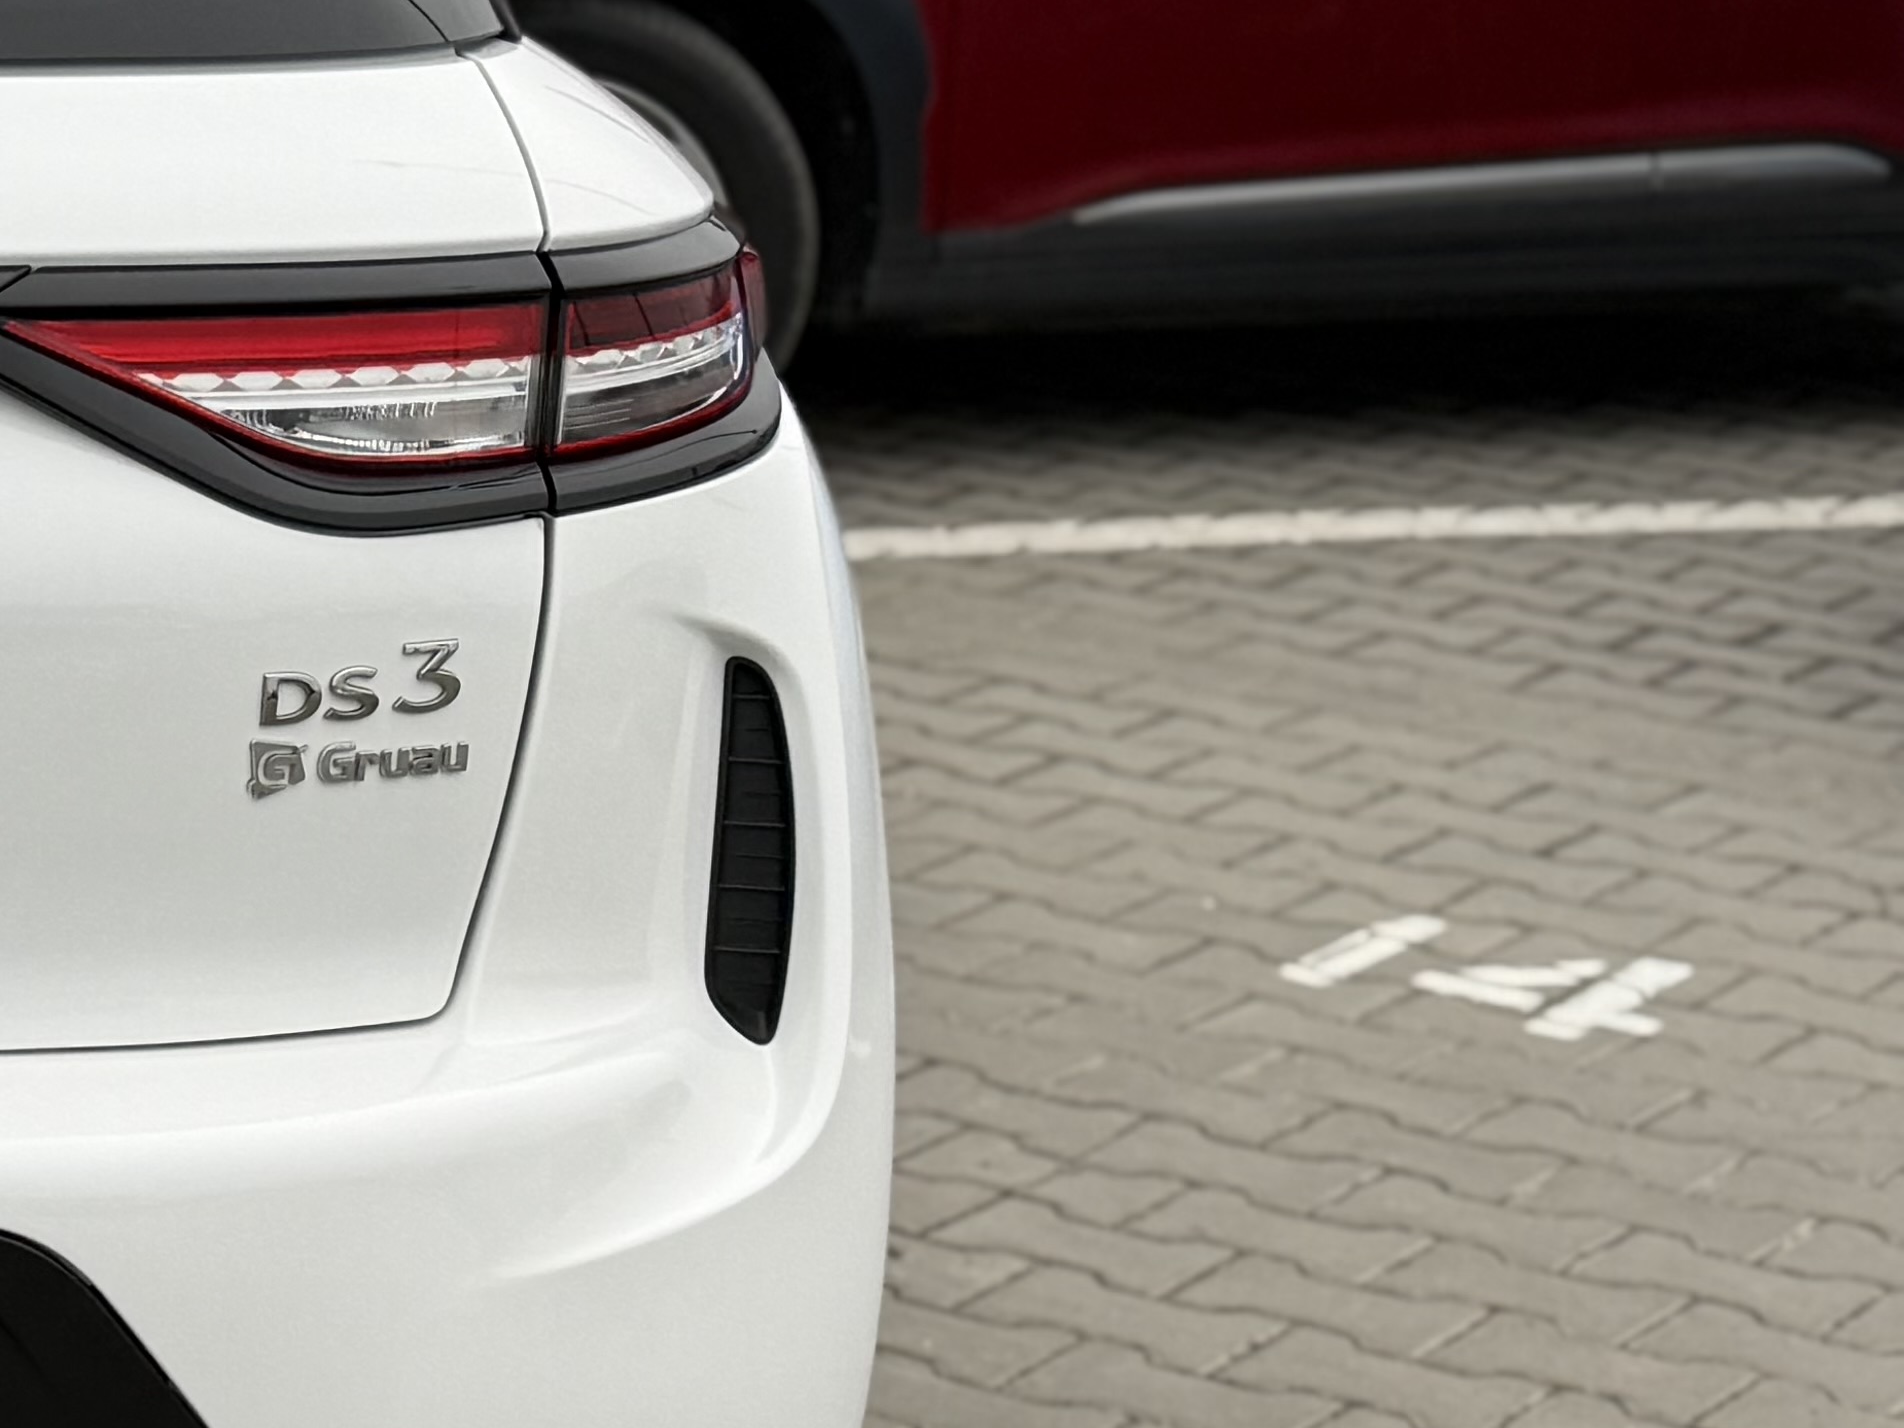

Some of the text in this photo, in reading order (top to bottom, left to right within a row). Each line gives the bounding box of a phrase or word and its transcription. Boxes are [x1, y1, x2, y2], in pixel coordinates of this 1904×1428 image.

[258, 637, 462, 727] DS 3
[316, 740, 470, 783] Gruau
[1279, 913, 1694, 1042] 14
